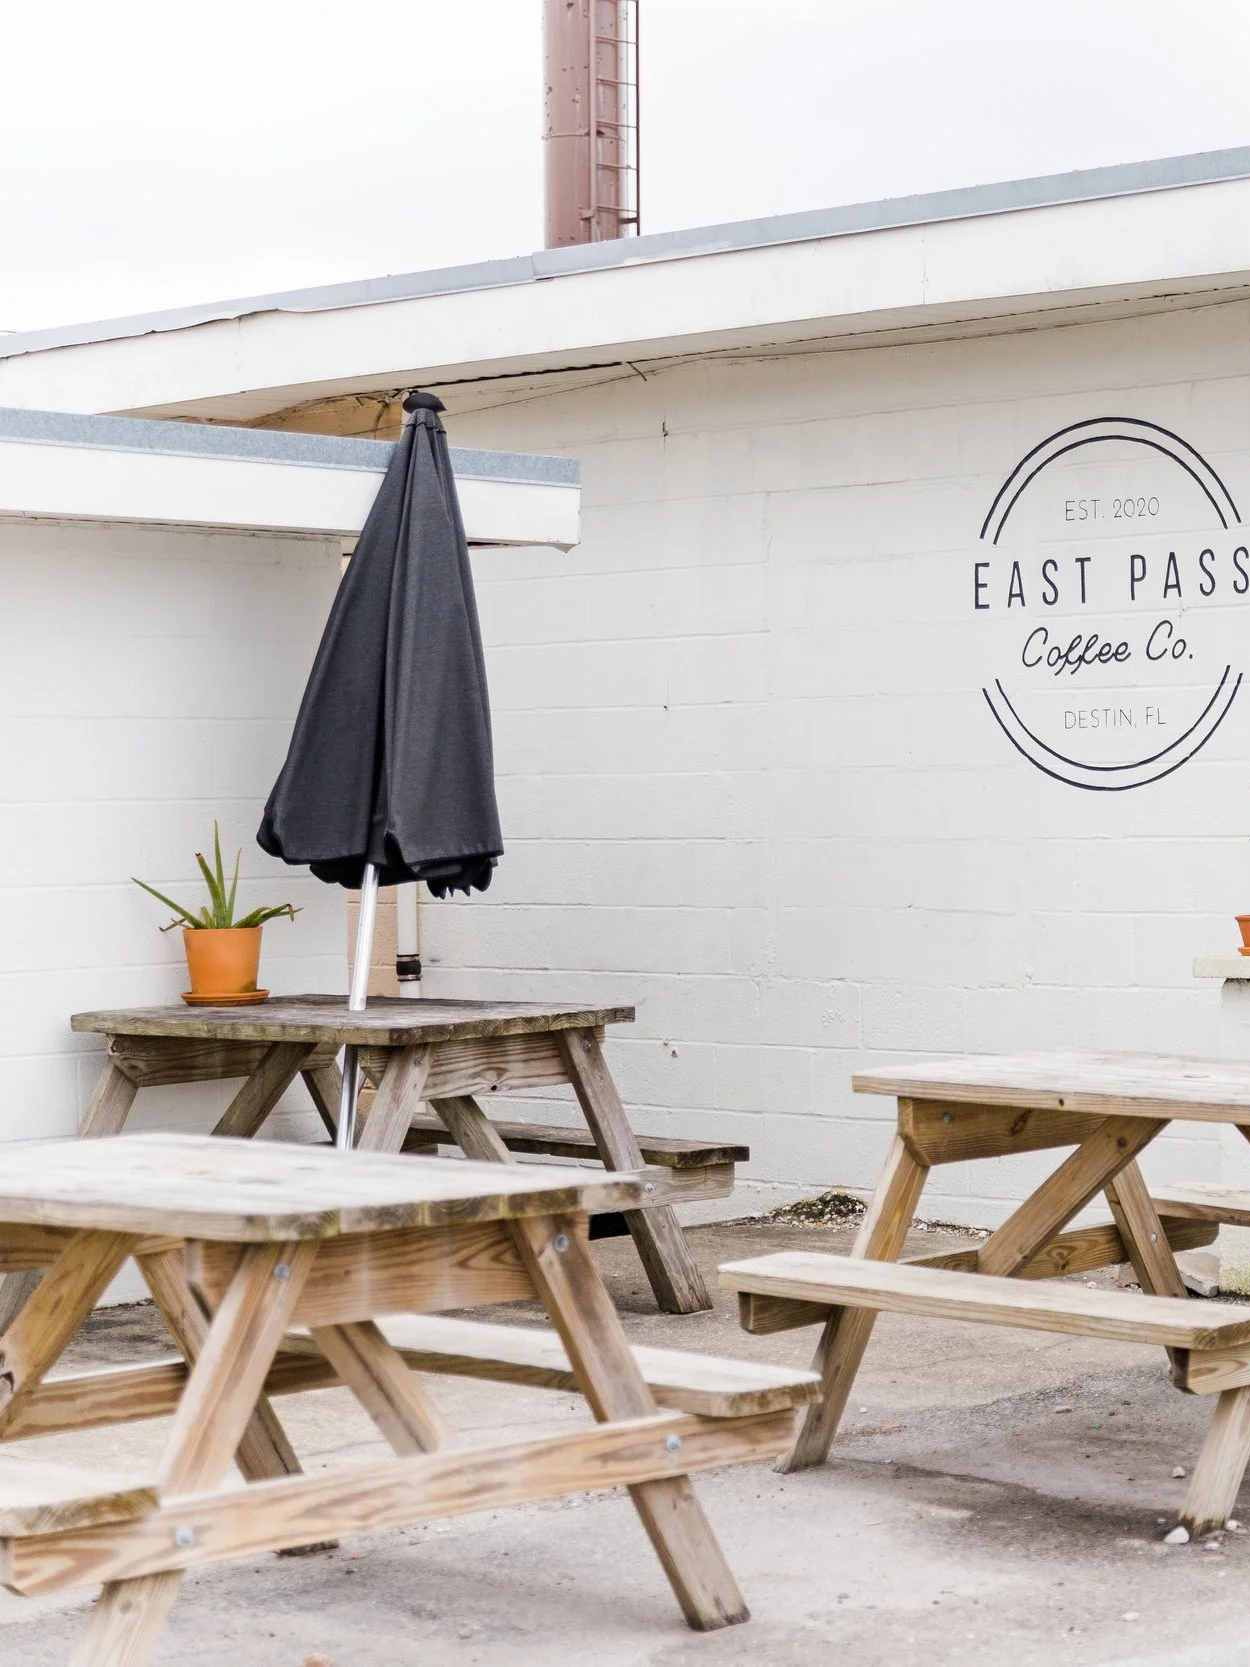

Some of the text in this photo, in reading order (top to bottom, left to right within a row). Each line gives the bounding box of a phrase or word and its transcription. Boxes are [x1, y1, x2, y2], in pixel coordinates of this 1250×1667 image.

[1065, 496, 1160, 522] EST. 2020
[974, 546, 1250, 610] EAST PASS
[1021, 619, 1194, 676] Coffee Co.
[1064, 705, 1167, 730] DESTIN, FL
